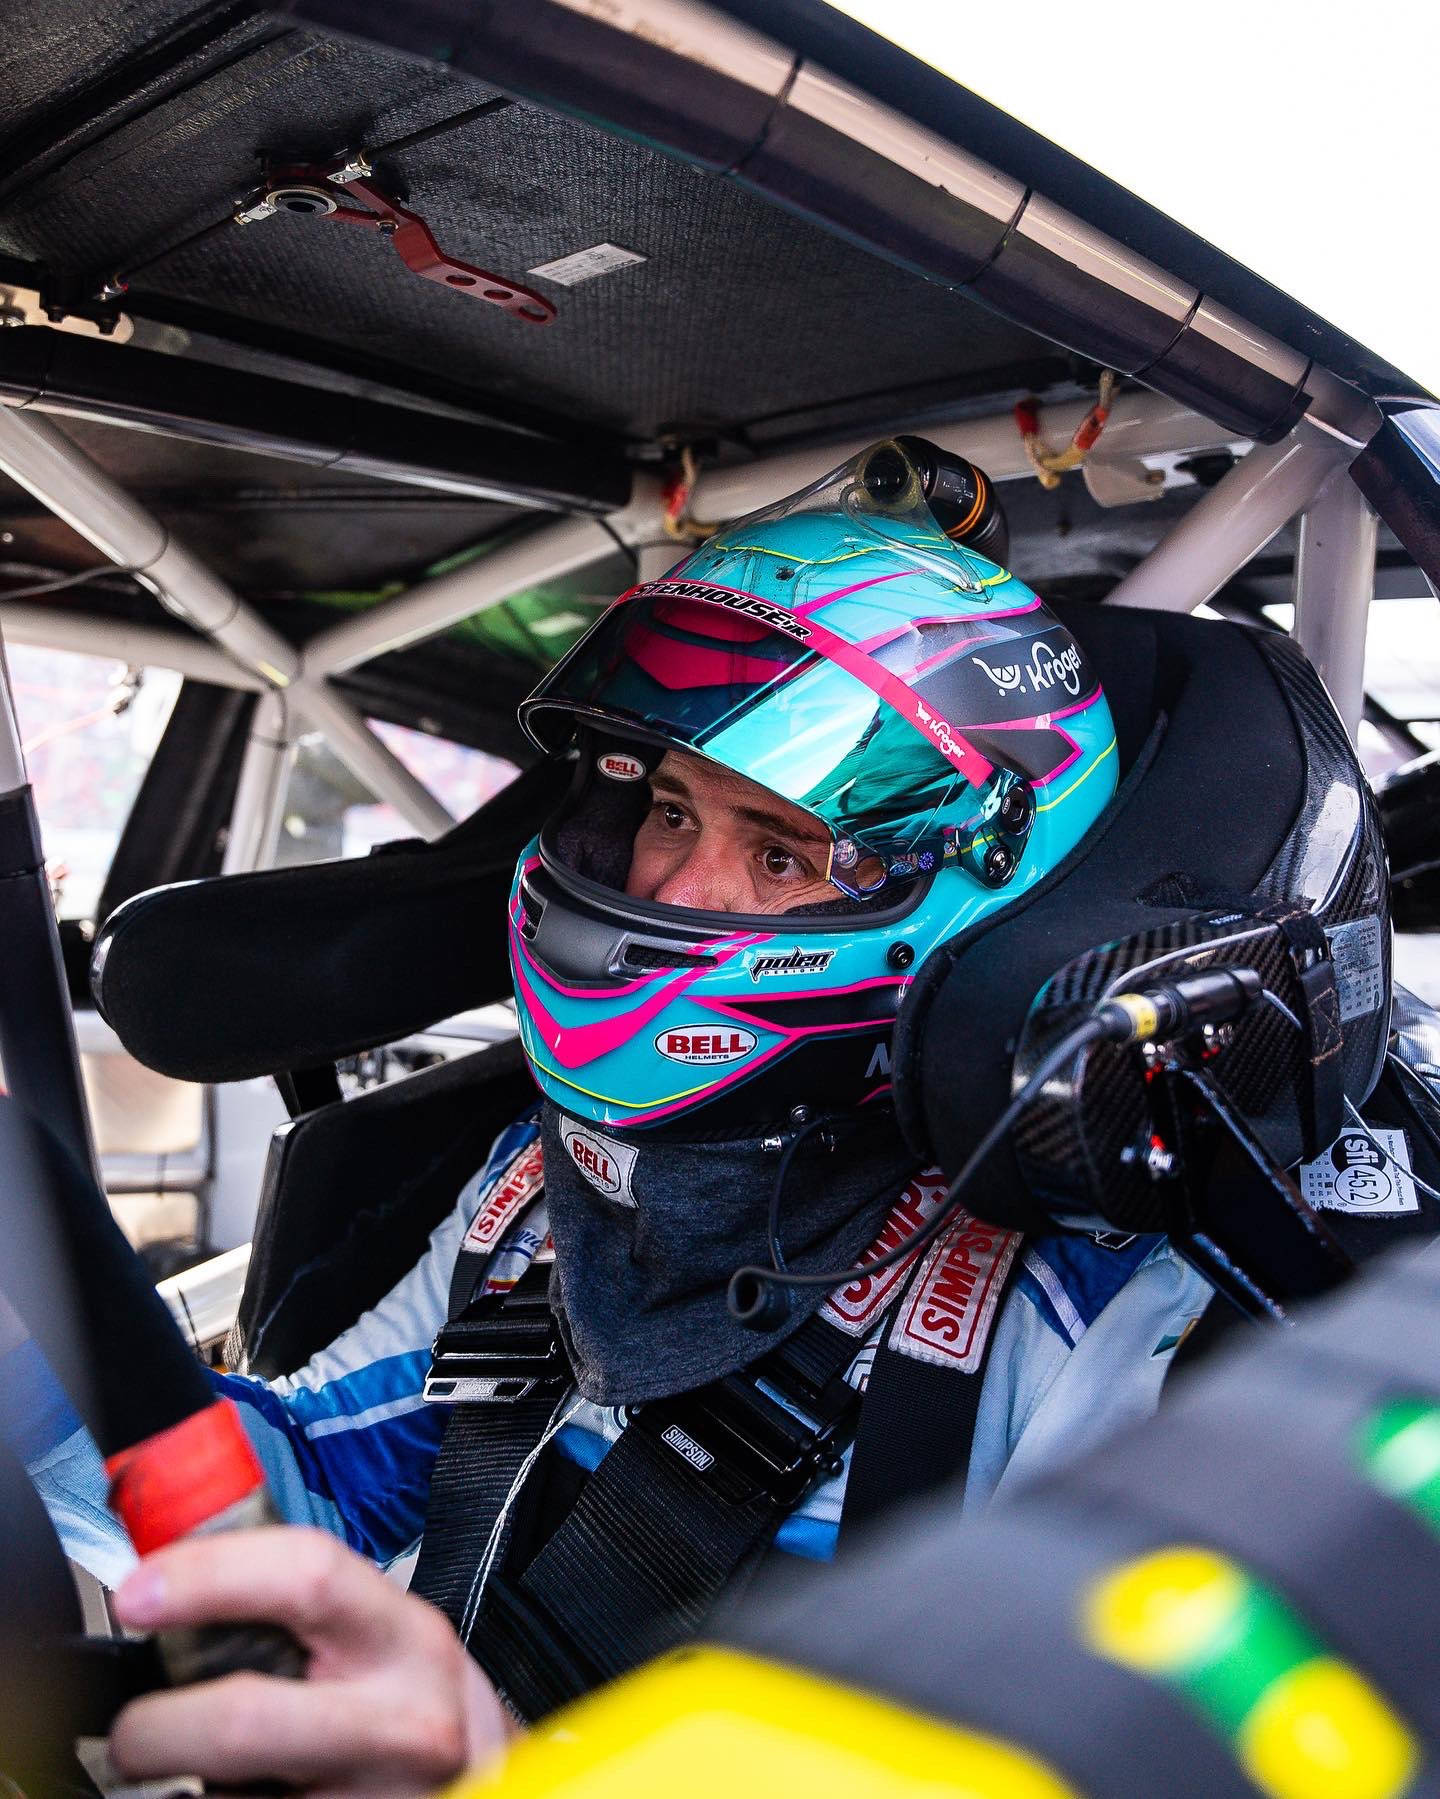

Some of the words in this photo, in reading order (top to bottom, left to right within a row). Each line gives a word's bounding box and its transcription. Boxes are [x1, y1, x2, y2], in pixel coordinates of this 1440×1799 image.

[782, 620, 812, 641] JR
[1025, 641, 1082, 695] Kroger
[929, 719, 965, 758] Kroger
[605, 758, 639, 775] BELL
[667, 1033, 748, 1054] BELL
[572, 1138, 614, 1185] BELL
[1344, 1138, 1379, 1165] sfi
[1347, 1169, 1379, 1201] 45.2
[665, 1428, 711, 1468] SIMPSON
